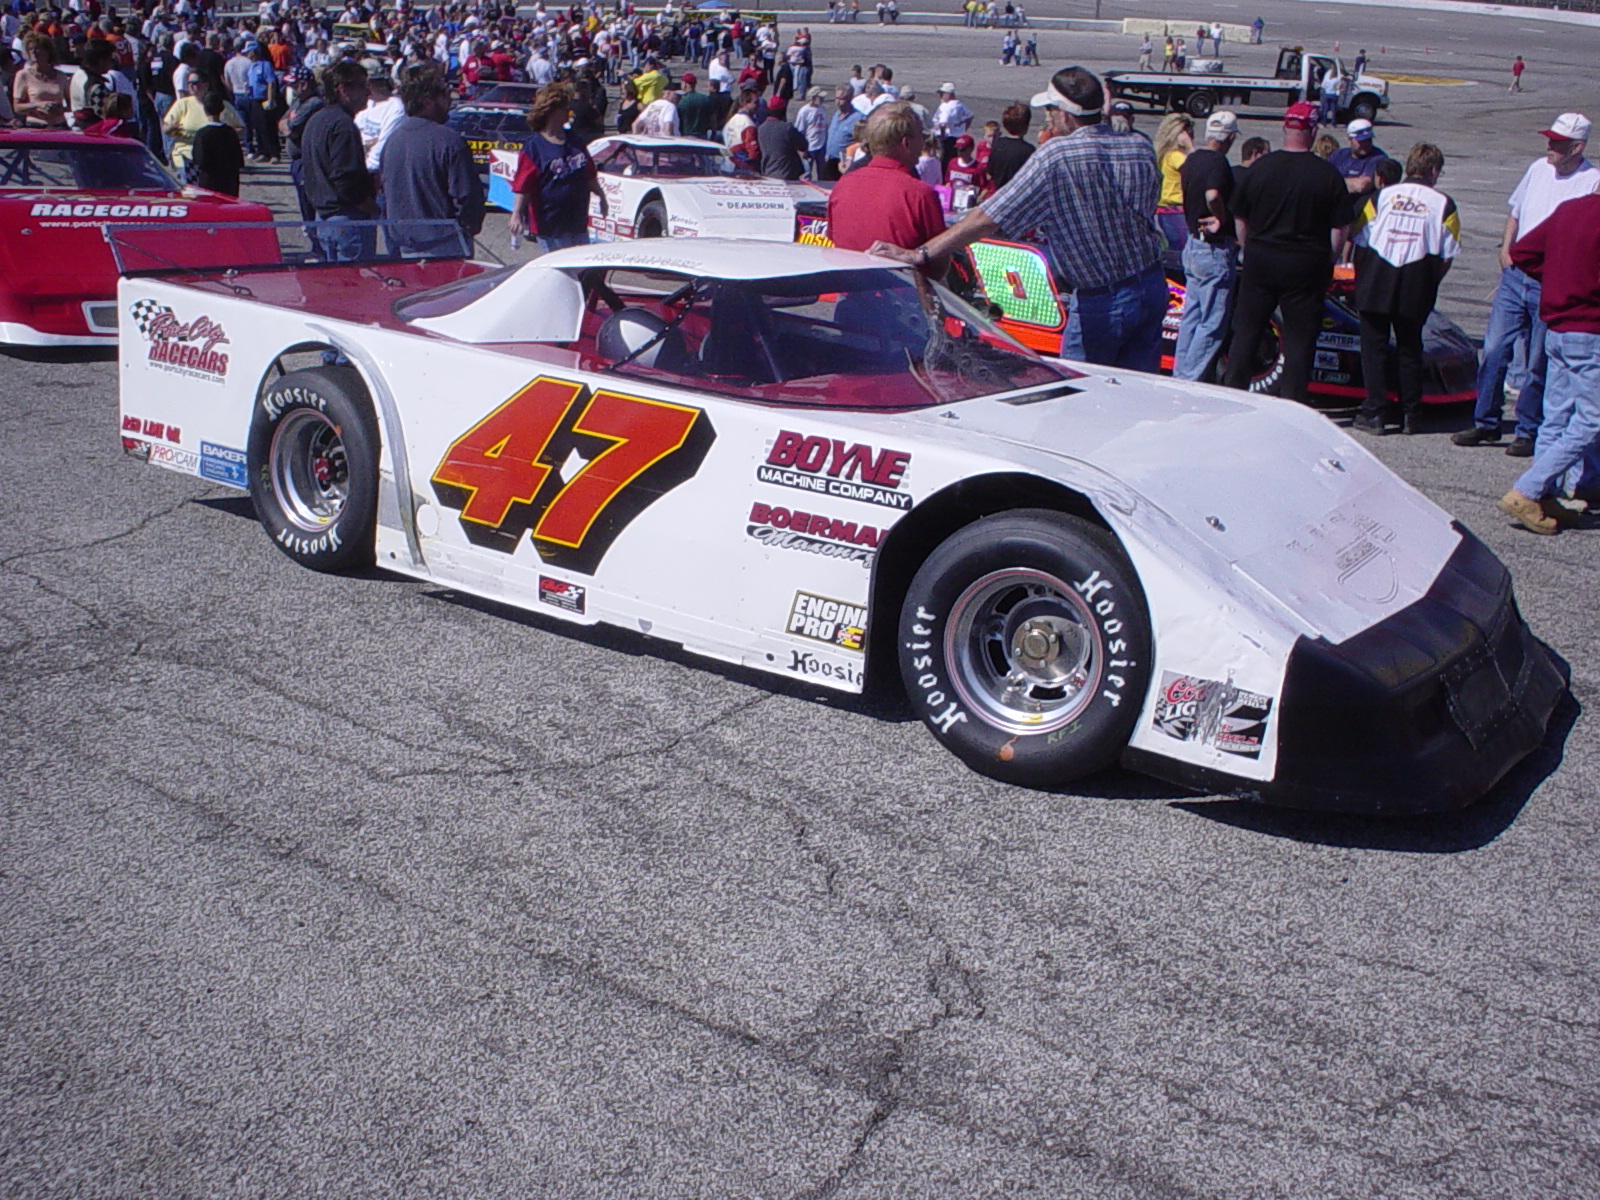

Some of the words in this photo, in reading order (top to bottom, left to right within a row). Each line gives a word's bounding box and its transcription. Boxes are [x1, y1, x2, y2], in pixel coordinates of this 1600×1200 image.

[30, 203, 188, 217] RACECARS
[148, 340, 229, 376] RACECARS
[263, 388, 327, 422] Hoosier
[430, 374, 715, 574] 47
[765, 429, 912, 488] BOYNE
[760, 467, 826, 492] MACHINE
[828, 482, 910, 508] COMPANY
[276, 523, 343, 554] Hoosier
[789, 612, 835, 641] PRO
[1074, 571, 1137, 707] Hoosier
[906, 605, 968, 734] Hoosier
